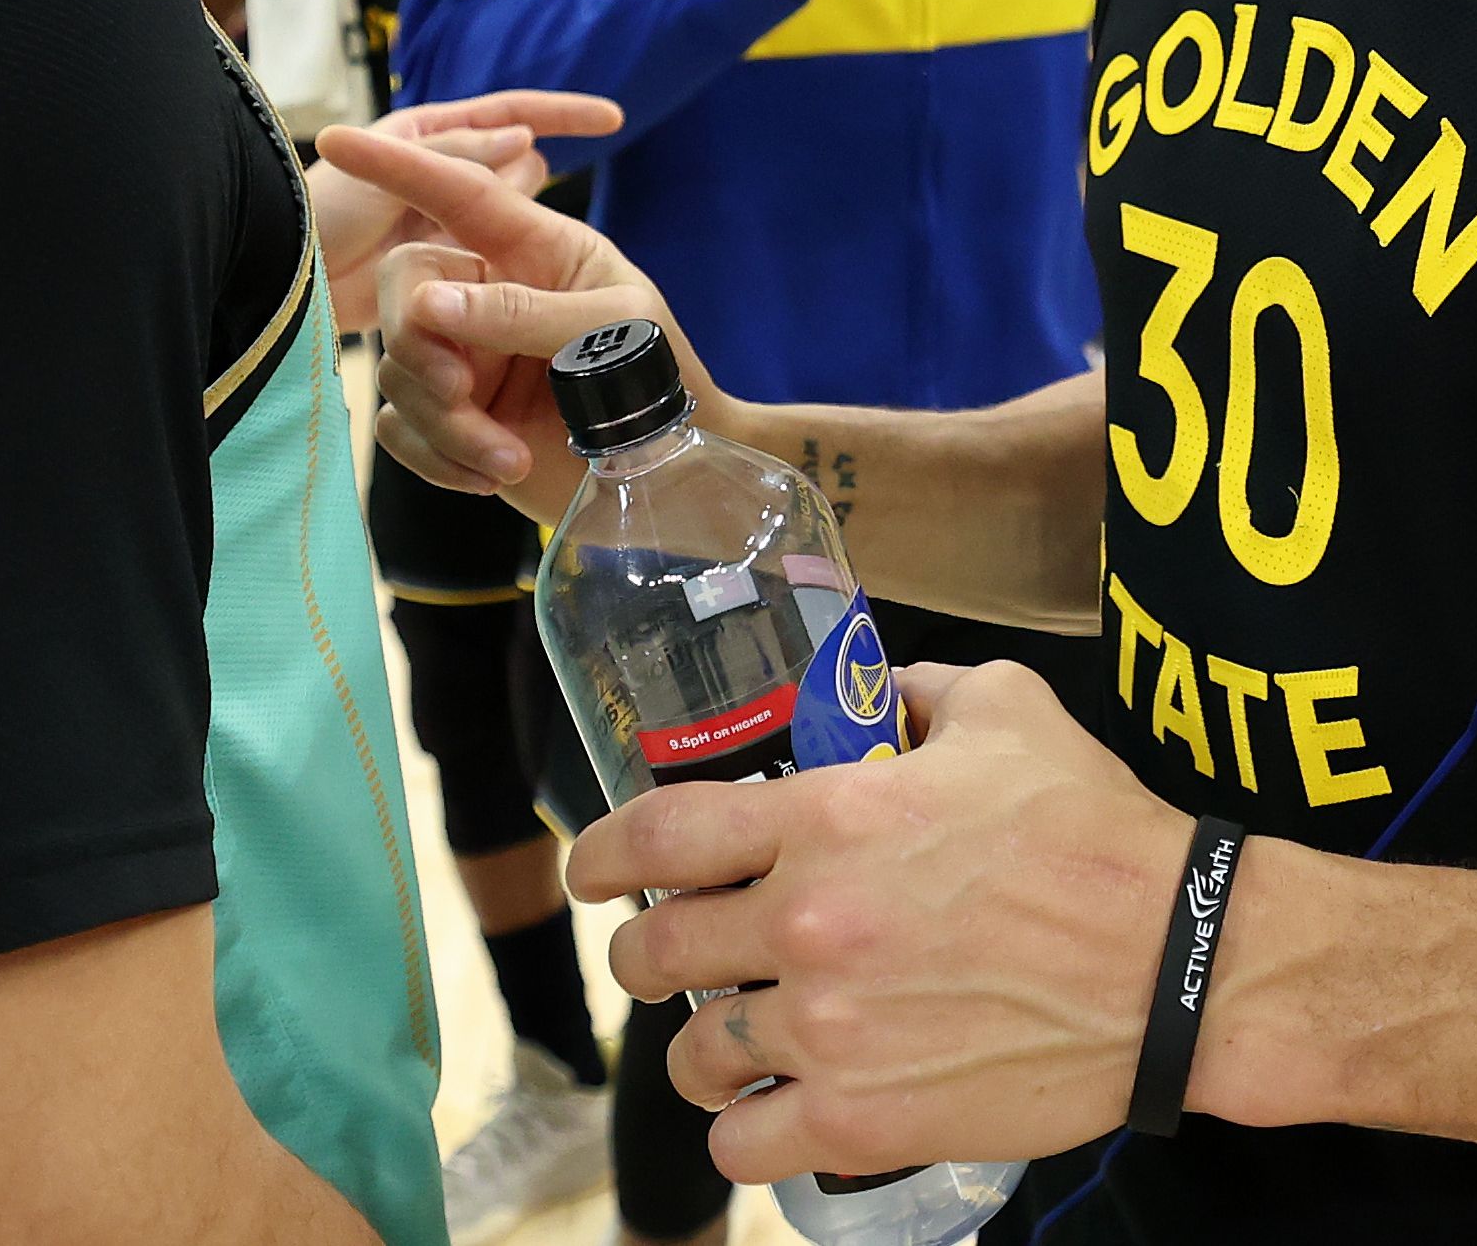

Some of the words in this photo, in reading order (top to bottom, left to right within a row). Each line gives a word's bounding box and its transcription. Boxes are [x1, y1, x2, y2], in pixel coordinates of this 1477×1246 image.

[1108, 202, 1340, 587] 30
[669, 731, 711, 750] 9.5pH
[713, 728, 730, 740] OR
[731, 710, 772, 734] HIGHER
[1099, 522, 1393, 808] TATE
[1180, 920, 1215, 1012] ACTIVE
